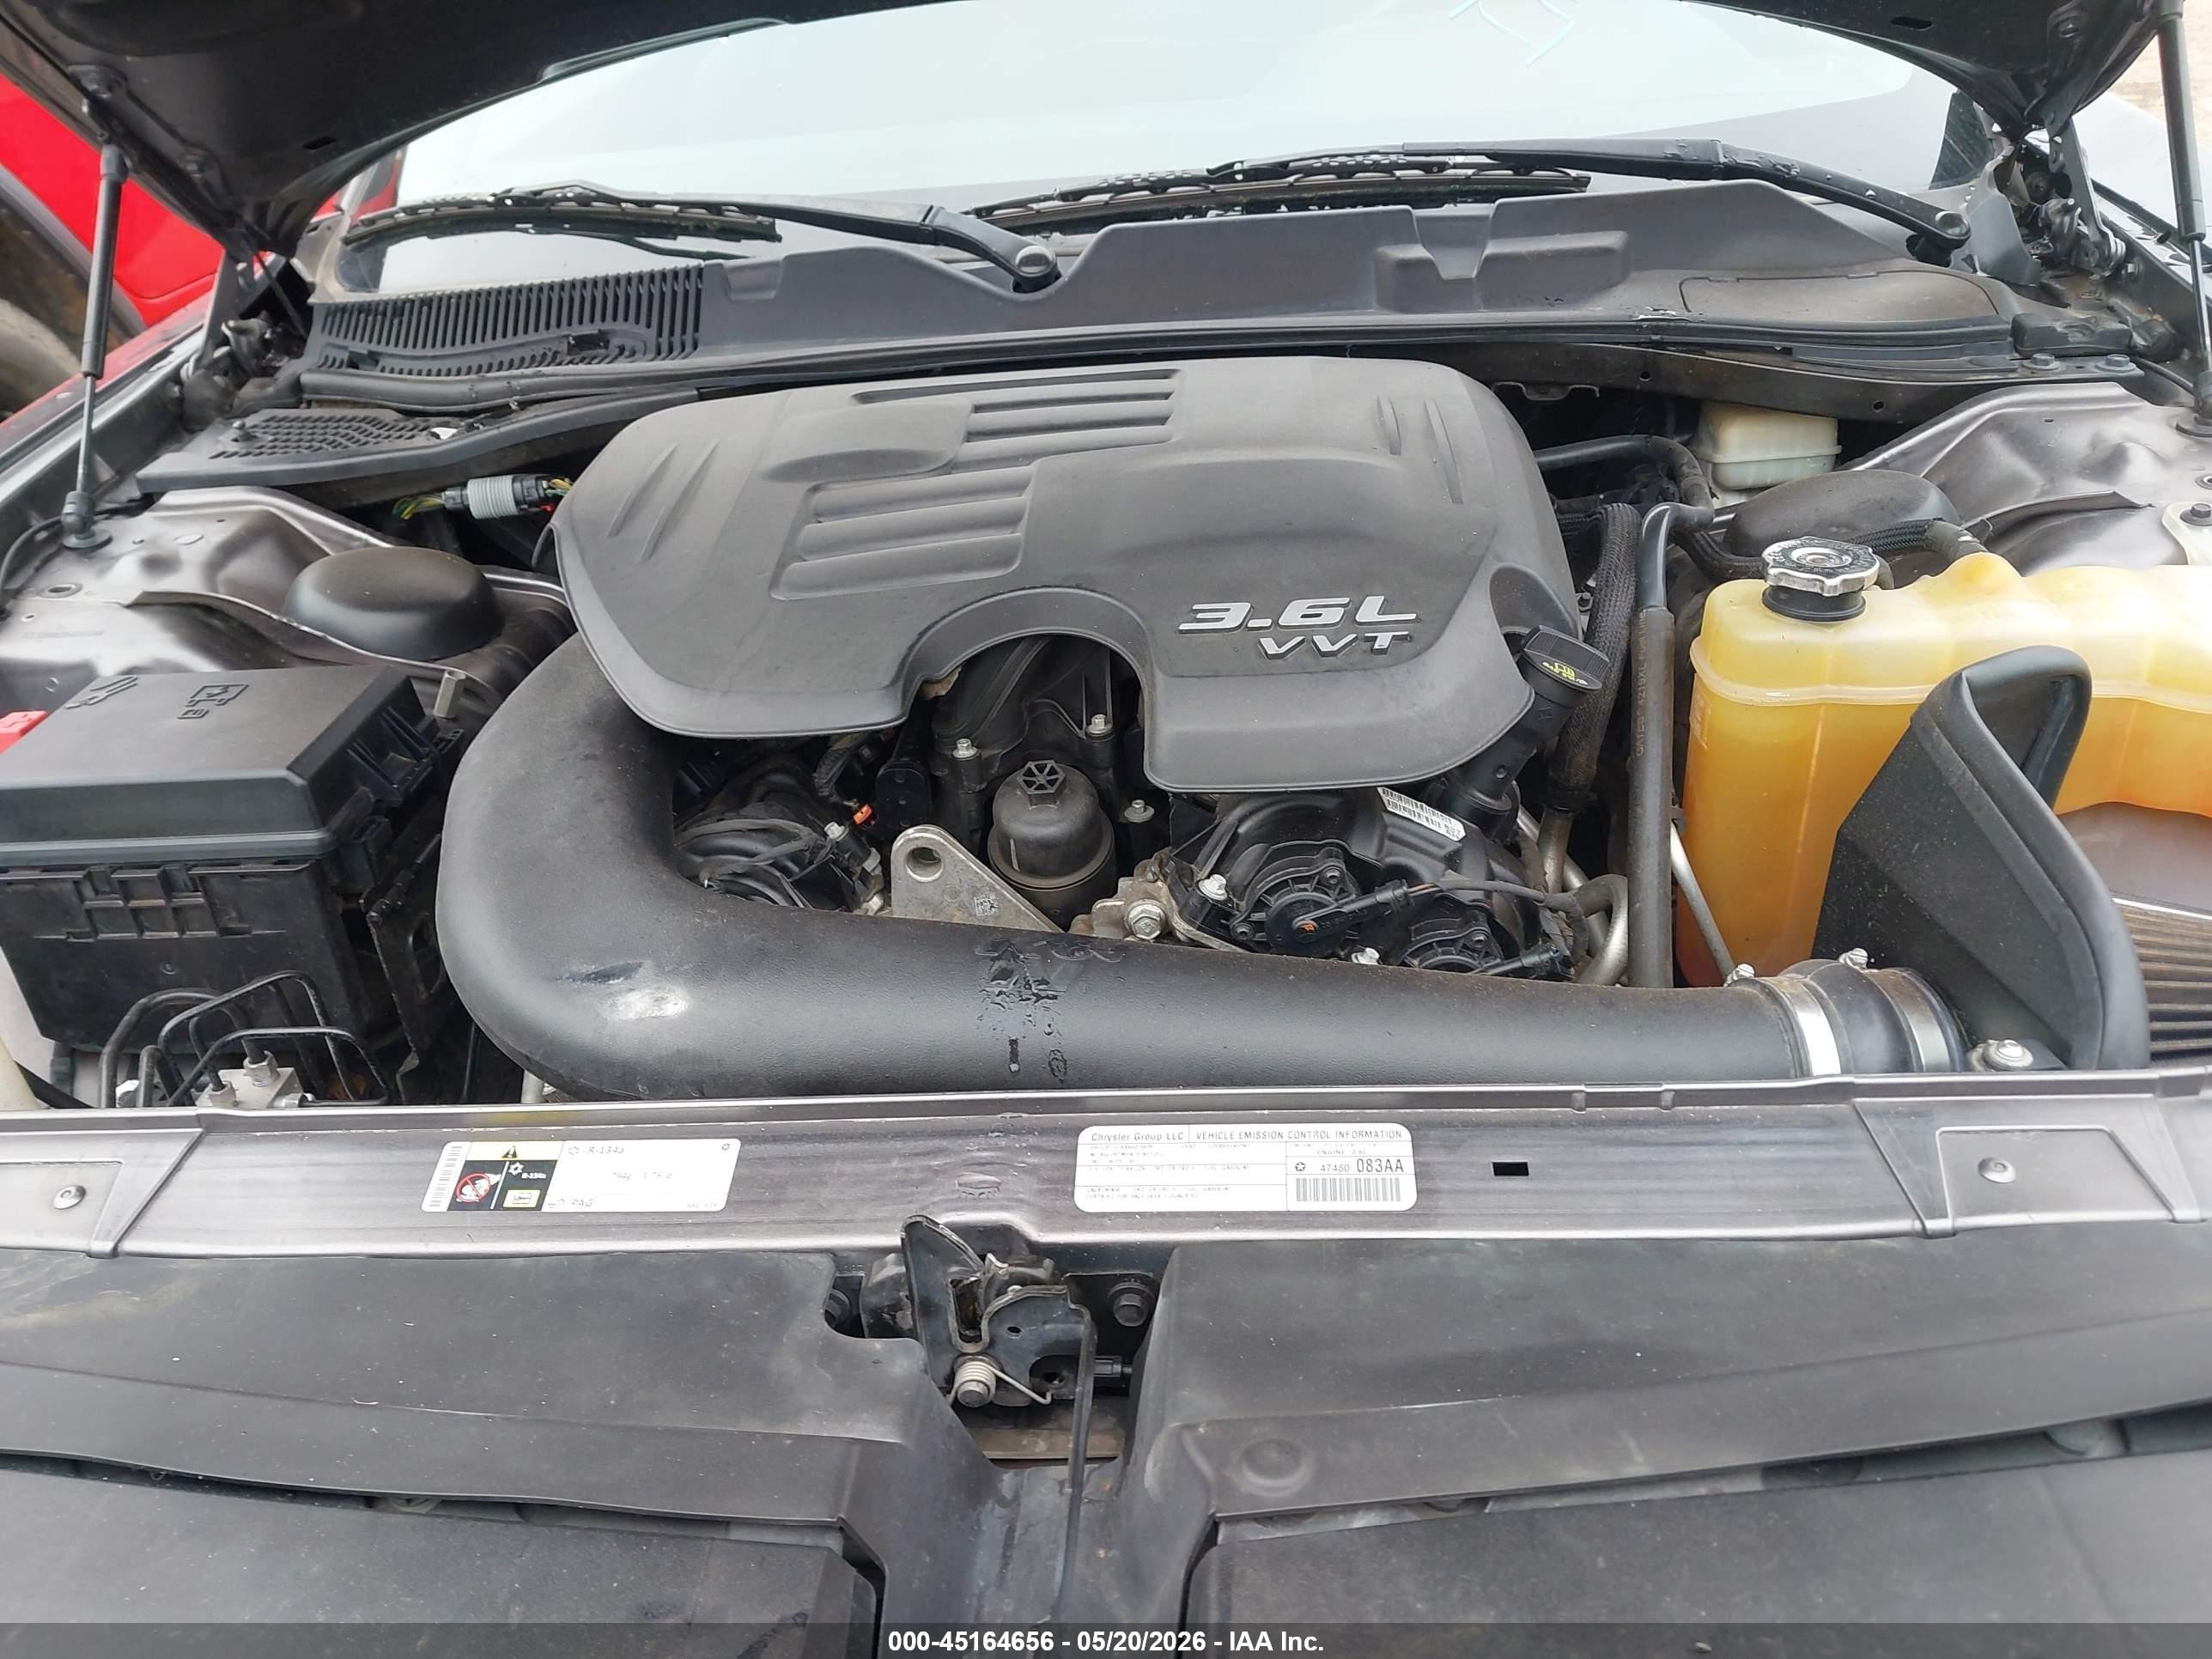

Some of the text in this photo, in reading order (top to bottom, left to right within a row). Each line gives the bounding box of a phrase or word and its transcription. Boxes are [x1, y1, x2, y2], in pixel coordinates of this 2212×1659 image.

[1178, 595, 1418, 634] 3.6L
[1258, 630, 1412, 659] VVT
[1091, 1131, 1184, 1141] Chrysler Group LLC
[1196, 1130, 1402, 1140] VEHICLE EMISSION CONTROL INFORMATION
[1356, 1158, 1404, 1173] 083AA
